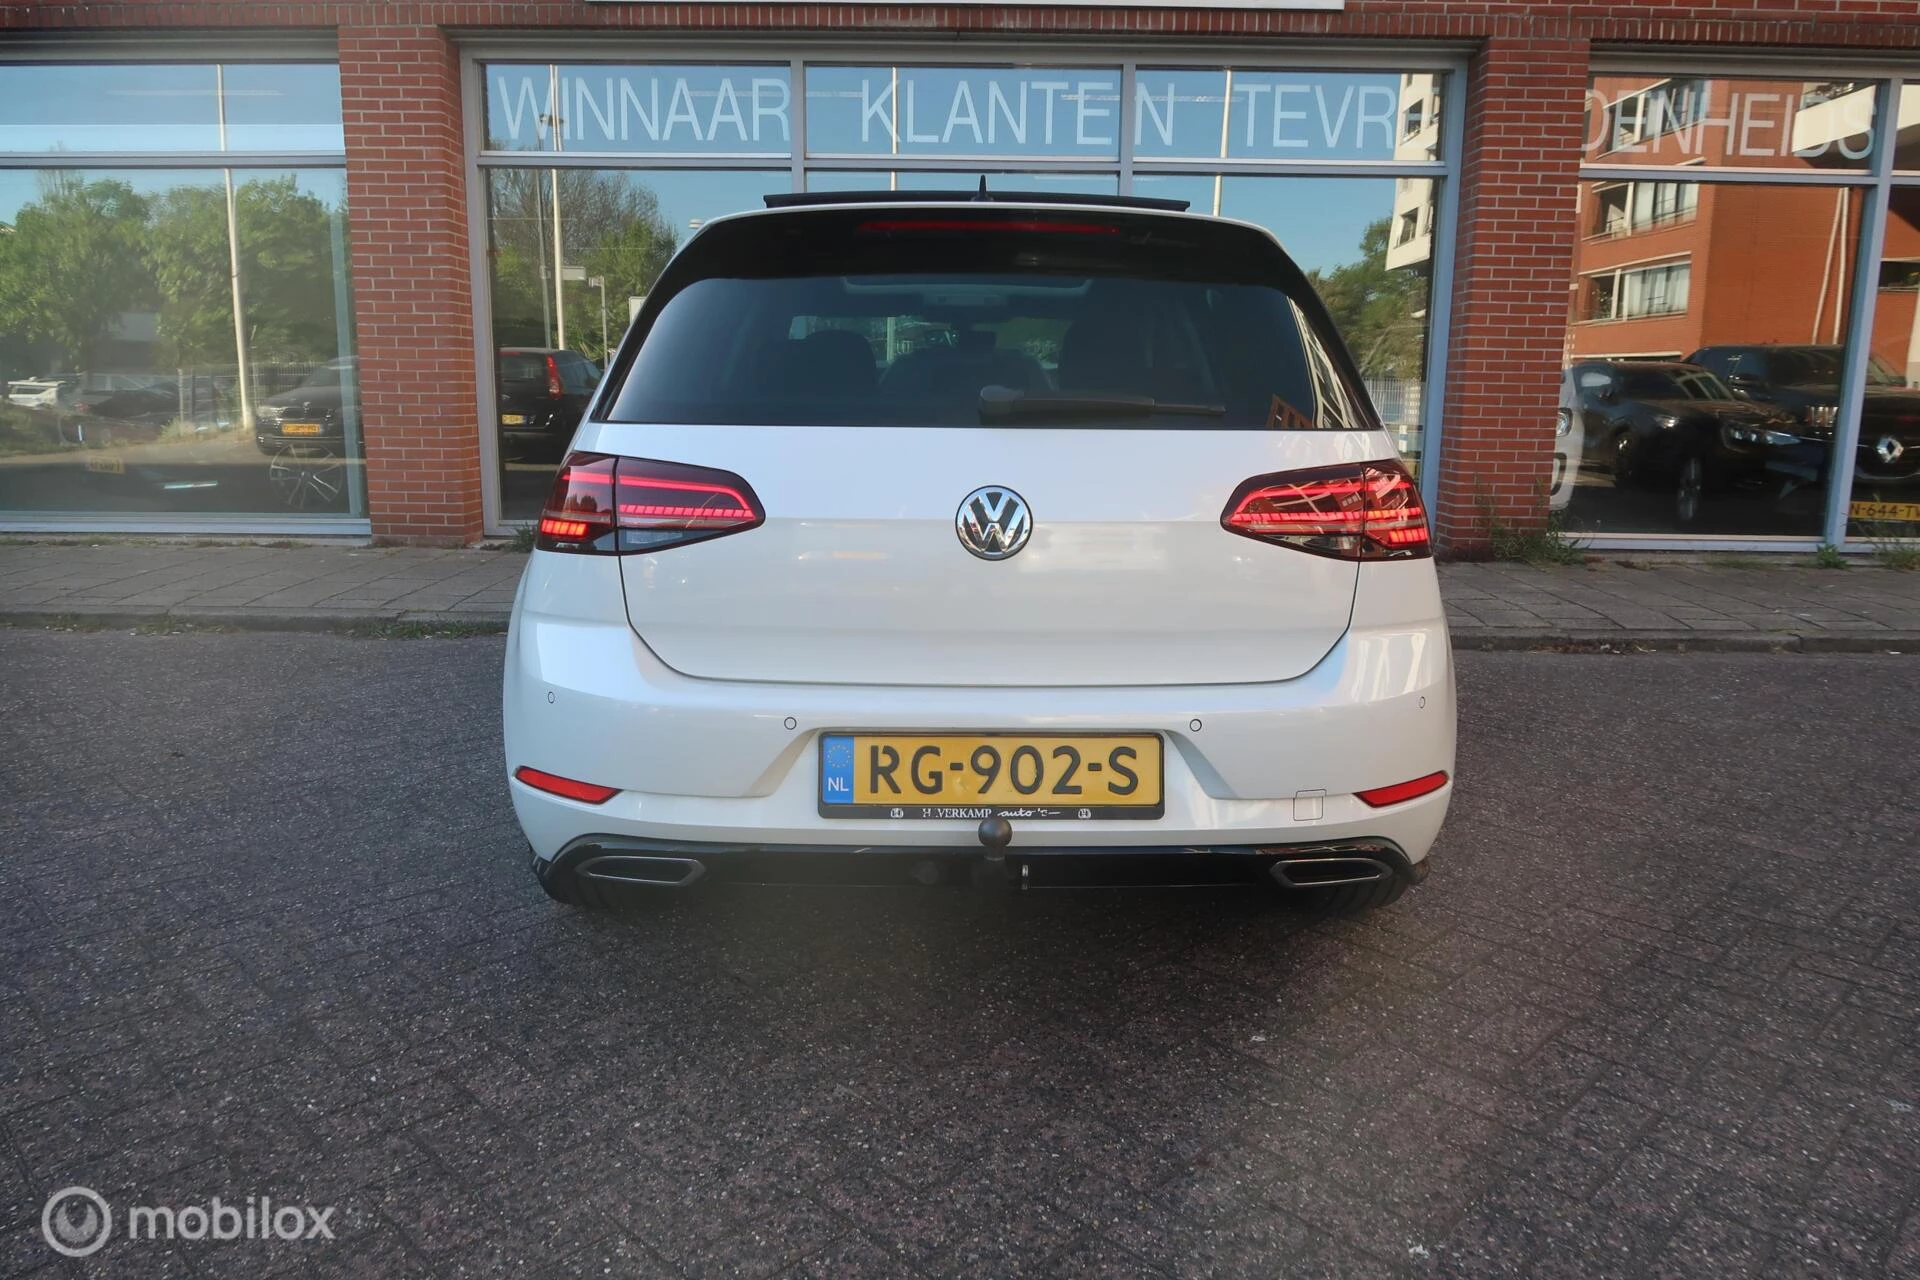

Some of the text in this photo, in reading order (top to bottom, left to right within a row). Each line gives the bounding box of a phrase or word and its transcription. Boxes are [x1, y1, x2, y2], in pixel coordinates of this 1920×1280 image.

[498, 77, 791, 141] WINNAAR
[827, 776, 850, 792] NL
[869, 745, 1139, 796] RG-902-S
